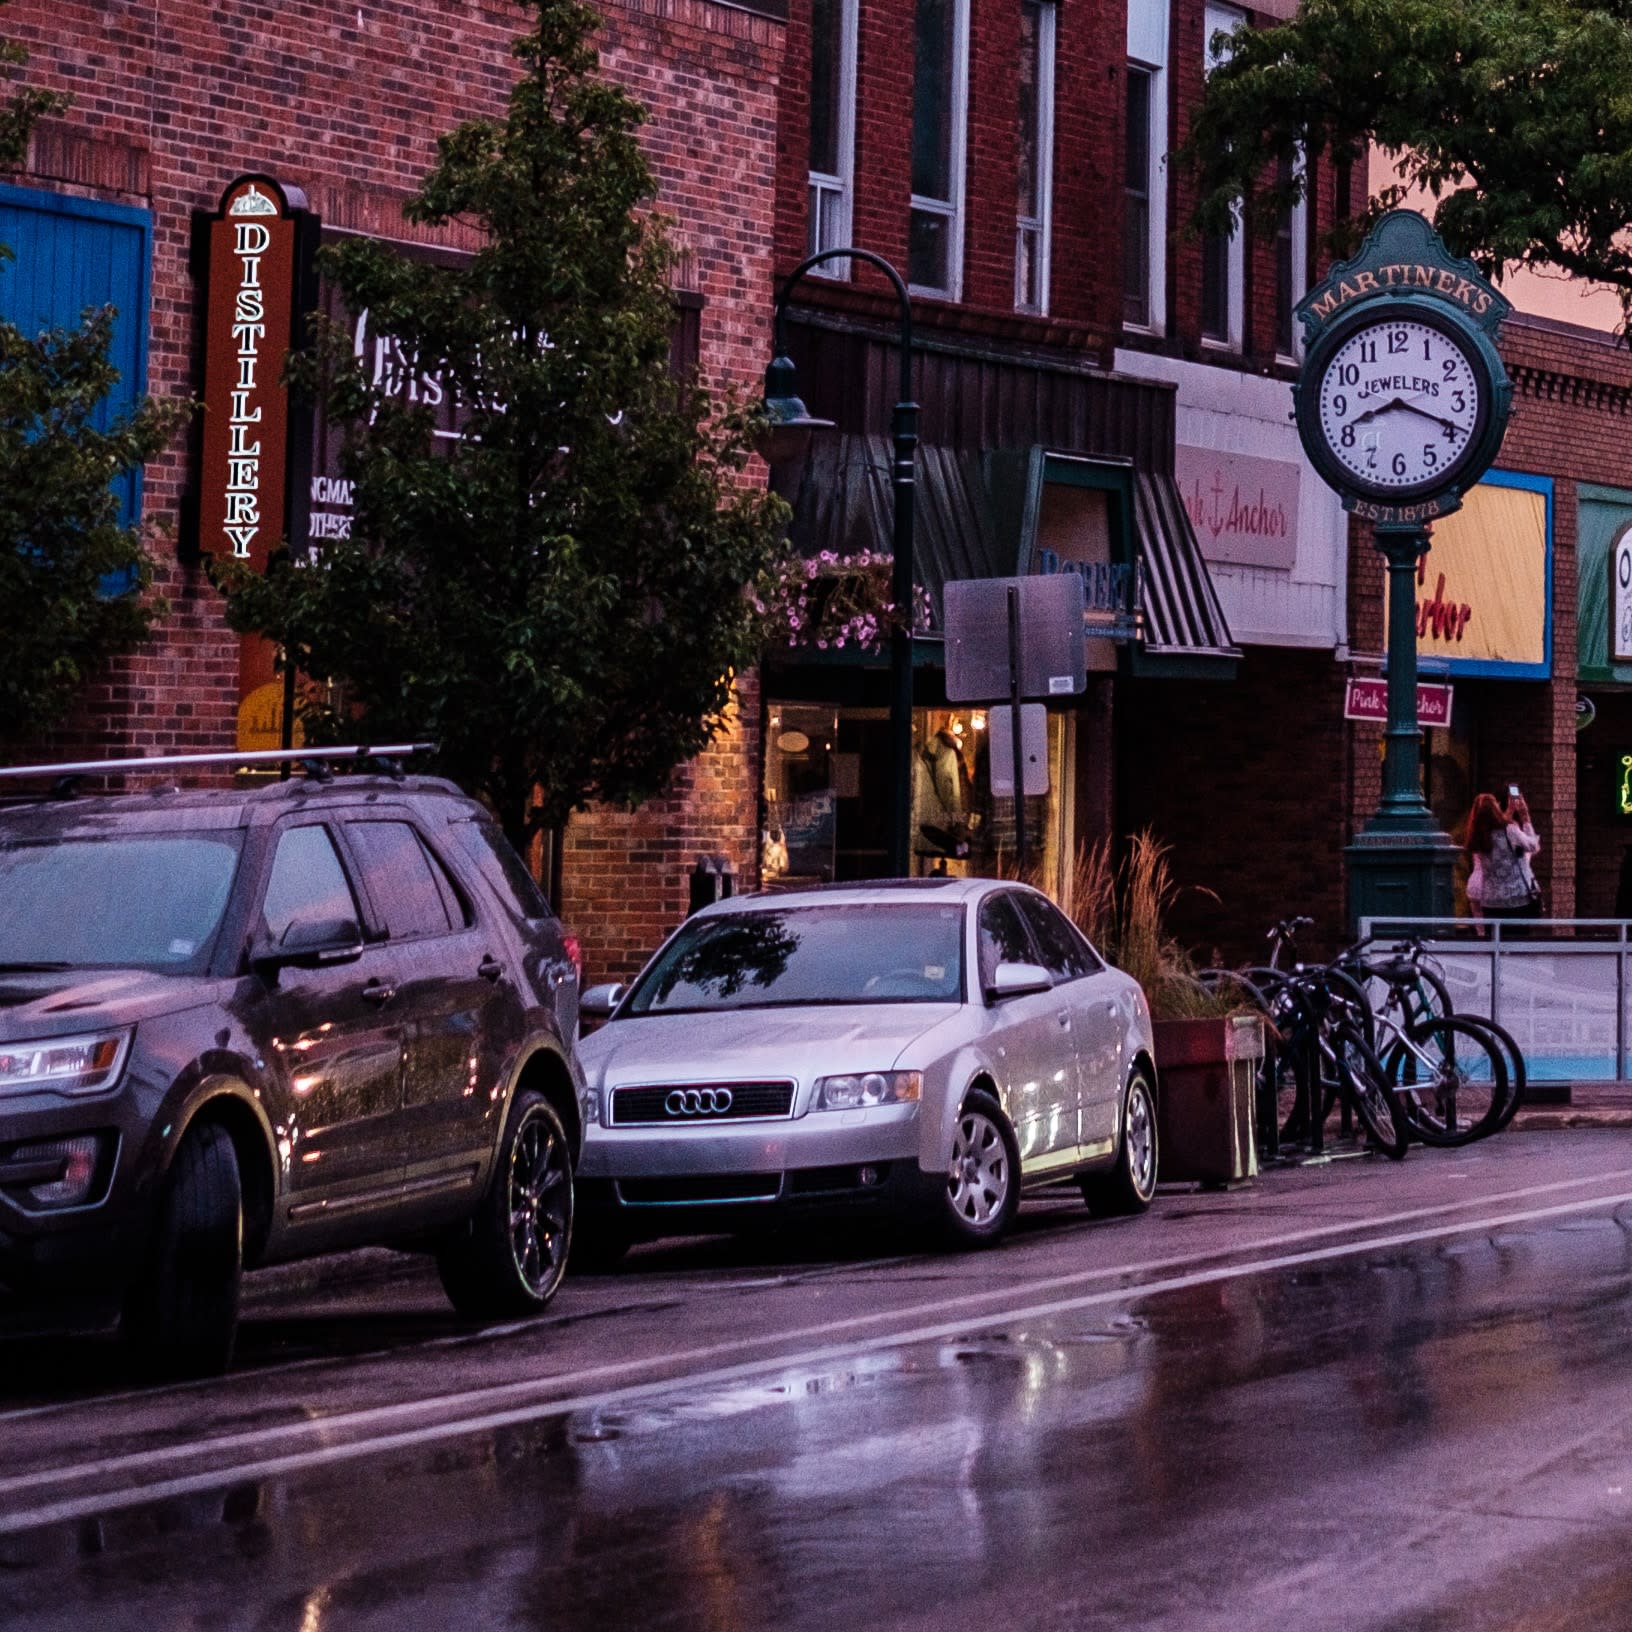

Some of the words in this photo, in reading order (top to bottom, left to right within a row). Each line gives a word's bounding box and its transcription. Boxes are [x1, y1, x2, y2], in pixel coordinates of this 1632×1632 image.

[1311, 264, 1494, 320] MARTINEK'S
[1360, 341, 1377, 363] 11
[1387, 330, 1409, 354] 12
[1423, 338, 1431, 361] 1
[1338, 363, 1360, 387] 10
[1442, 360, 1458, 383] 2
[224, 223, 270, 558] DISTILLERY
[1358, 376, 1440, 399] JEWELERS
[1333, 394, 1347, 417] 9
[1451, 389, 1466, 412] 3
[1341, 424, 1355, 448] 8
[1442, 421, 1457, 444] 4
[1391, 453, 1406, 476] 6
[1423, 444, 1437, 467] 5
[1226, 484, 1287, 537] Anchor
[1399, 501, 1440, 522] 1878
[1351, 687, 1380, 709] Pink
